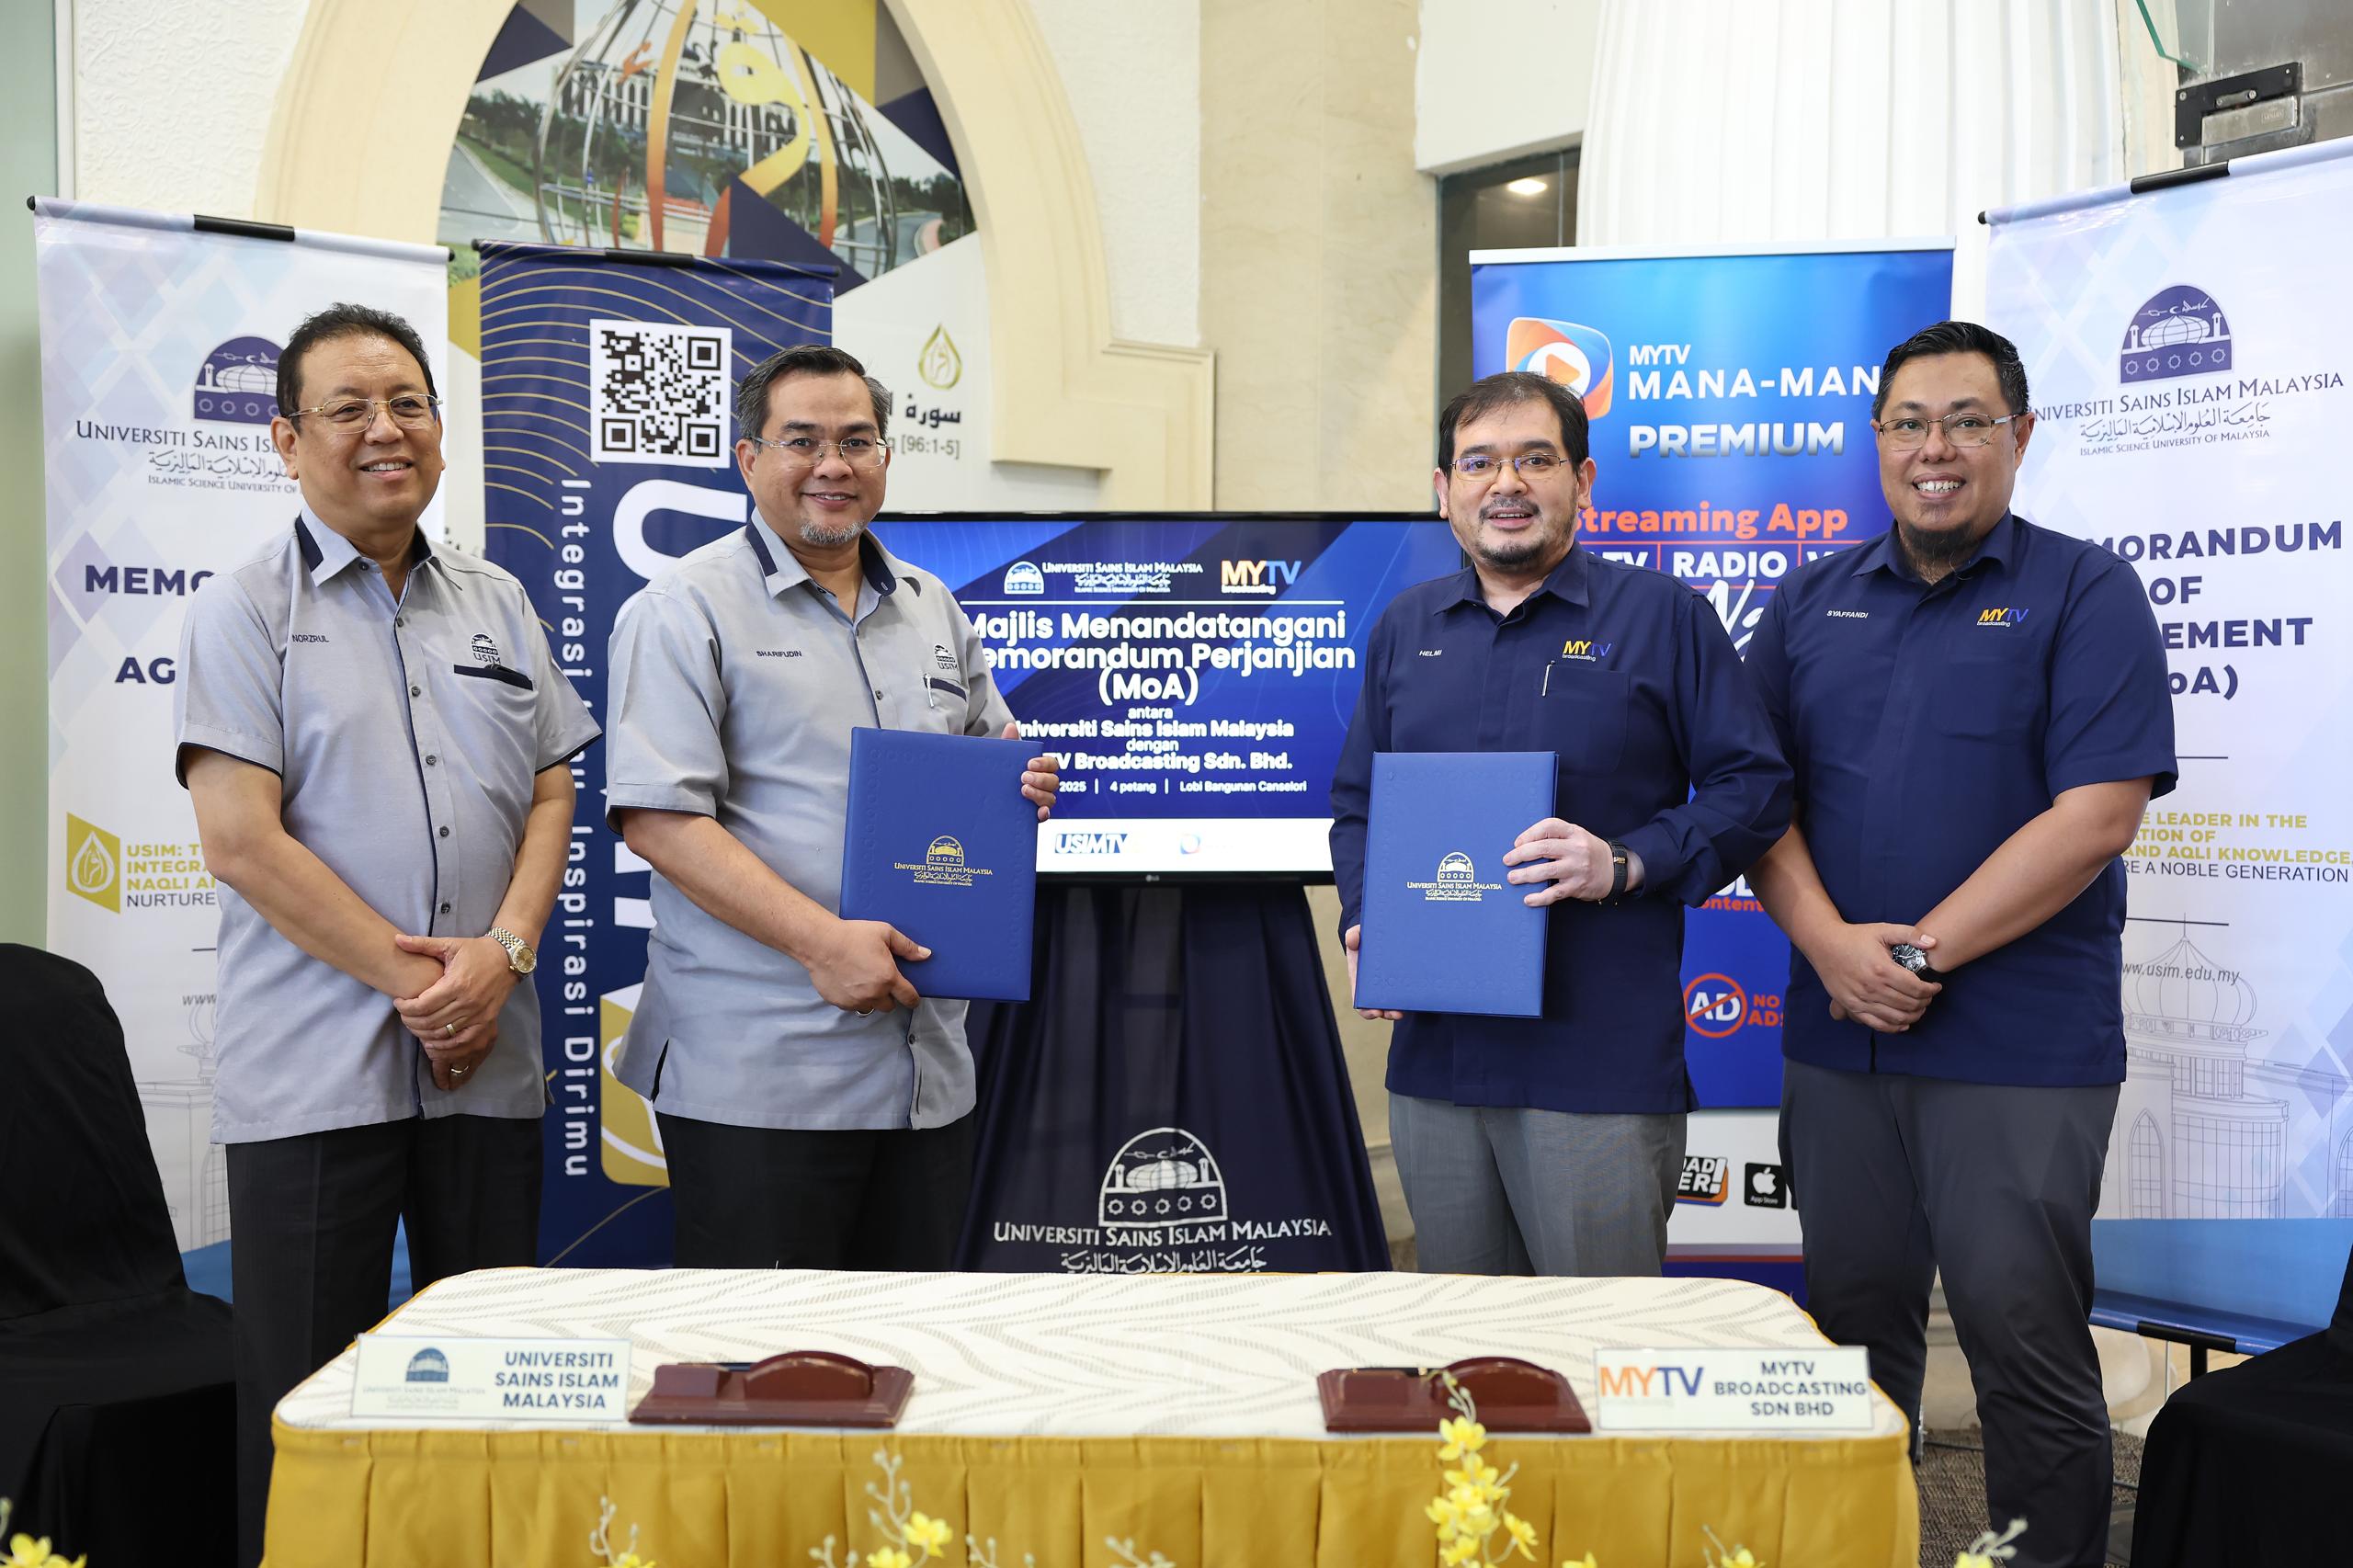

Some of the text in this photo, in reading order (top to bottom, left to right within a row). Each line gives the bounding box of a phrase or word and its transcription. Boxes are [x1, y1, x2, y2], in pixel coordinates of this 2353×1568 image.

[1629, 344, 1691, 366] MYTV
[1629, 365, 1880, 400] MANA-MAN
[2029, 372, 2345, 423] NIVERSITI SAINS ISLAM MALAYSIA
[76, 420, 279, 454] UNIVERSITI SAINS ISL
[1629, 422, 1845, 459] PREMIUM
[2080, 429, 2270, 457] ISLAMIC SCIENCE UNIVERSITY OF MALAYSIA
[148, 474, 186, 486] ISLAMIC
[188, 477, 225, 489] SCIENCE
[228, 480, 281, 493] UNIVERSITY
[1767, 503, 1848, 539] App
[1041, 562, 1204, 574] UNIVERSITI SAINS ISLAM MALAYSIA
[1221, 560, 1302, 585] MYTV
[1672, 551, 1789, 578] RADIO
[553, 479, 594, 677] Integrasi
[2149, 575, 2202, 606] OF
[1826, 610, 1869, 619] SYAFFANDI
[1978, 608, 2029, 622] MYTV
[1061, 610, 1347, 647] Menandatangani
[2162, 617, 2313, 650] EMENT
[291, 634, 330, 643] NORZRUL
[1418, 649, 1443, 657] HELMI
[1563, 640, 1612, 657] MYTV
[473, 653, 501, 665] USIM
[938, 662, 959, 671] USIM
[983, 642, 1356, 676] emorandum Perjanjian
[1098, 667, 1199, 706] (MoA)
[2168, 664, 2239, 700] oA)
[1127, 706, 1174, 719] antara
[1101, 720, 1154, 737] Sains
[1156, 720, 1207, 737] Islam
[1210, 719, 1294, 741] Malaysia
[1126, 738, 1179, 755] dengan
[1074, 752, 1200, 773] Broadcasting
[1203, 752, 1246, 769] Sdn.
[1250, 752, 1293, 769] Bhd.
[1059, 780, 1087, 792] 2025
[1109, 781, 1119, 792] 4
[1120, 781, 1157, 794] petang
[1179, 780, 1203, 792] Lobi
[1204, 780, 1256, 794] Bangunan
[2156, 812, 2232, 827] LEADER
[2239, 813, 2259, 827] IN
[2267, 814, 2308, 828] THE
[2189, 829, 2216, 843] OF
[127, 844, 182, 857] USIM:
[2167, 846, 2211, 859] AQLI
[127, 860, 206, 874] INTEGR
[894, 862, 926, 870] UNIVERSITI
[963, 867, 994, 876] MALAYSIA
[2144, 861, 2156, 874] A
[2161, 862, 2219, 877] NOBLE
[2225, 864, 2348, 882] GENERATION
[127, 877, 188, 891] NAQLI
[1406, 881, 1438, 890] UNIVERSITI
[1473, 882, 1503, 891] MALAYSIA
[127, 892, 216, 908] NURTURE
[557, 826, 594, 1016] Inspirasi
[2121, 962, 2240, 986] ww.usim.edu.my
[1753, 994, 1780, 1007] NO
[563, 1036, 595, 1176] Dirimu
[993, 1218, 1333, 1247] UNIVERSITI SAINS ISLAM MALAYSIA
[505, 1351, 614, 1368] UNIVERSITI
[1761, 1361, 1815, 1376] MYTV
[494, 1371, 619, 1388] SAINS ISLAM
[1599, 1367, 1705, 1397] MYTV
[1714, 1381, 1867, 1396] BROADCASTING
[503, 1392, 607, 1409] MALAYSIA
[1751, 1402, 1835, 1416] SDN BHD
